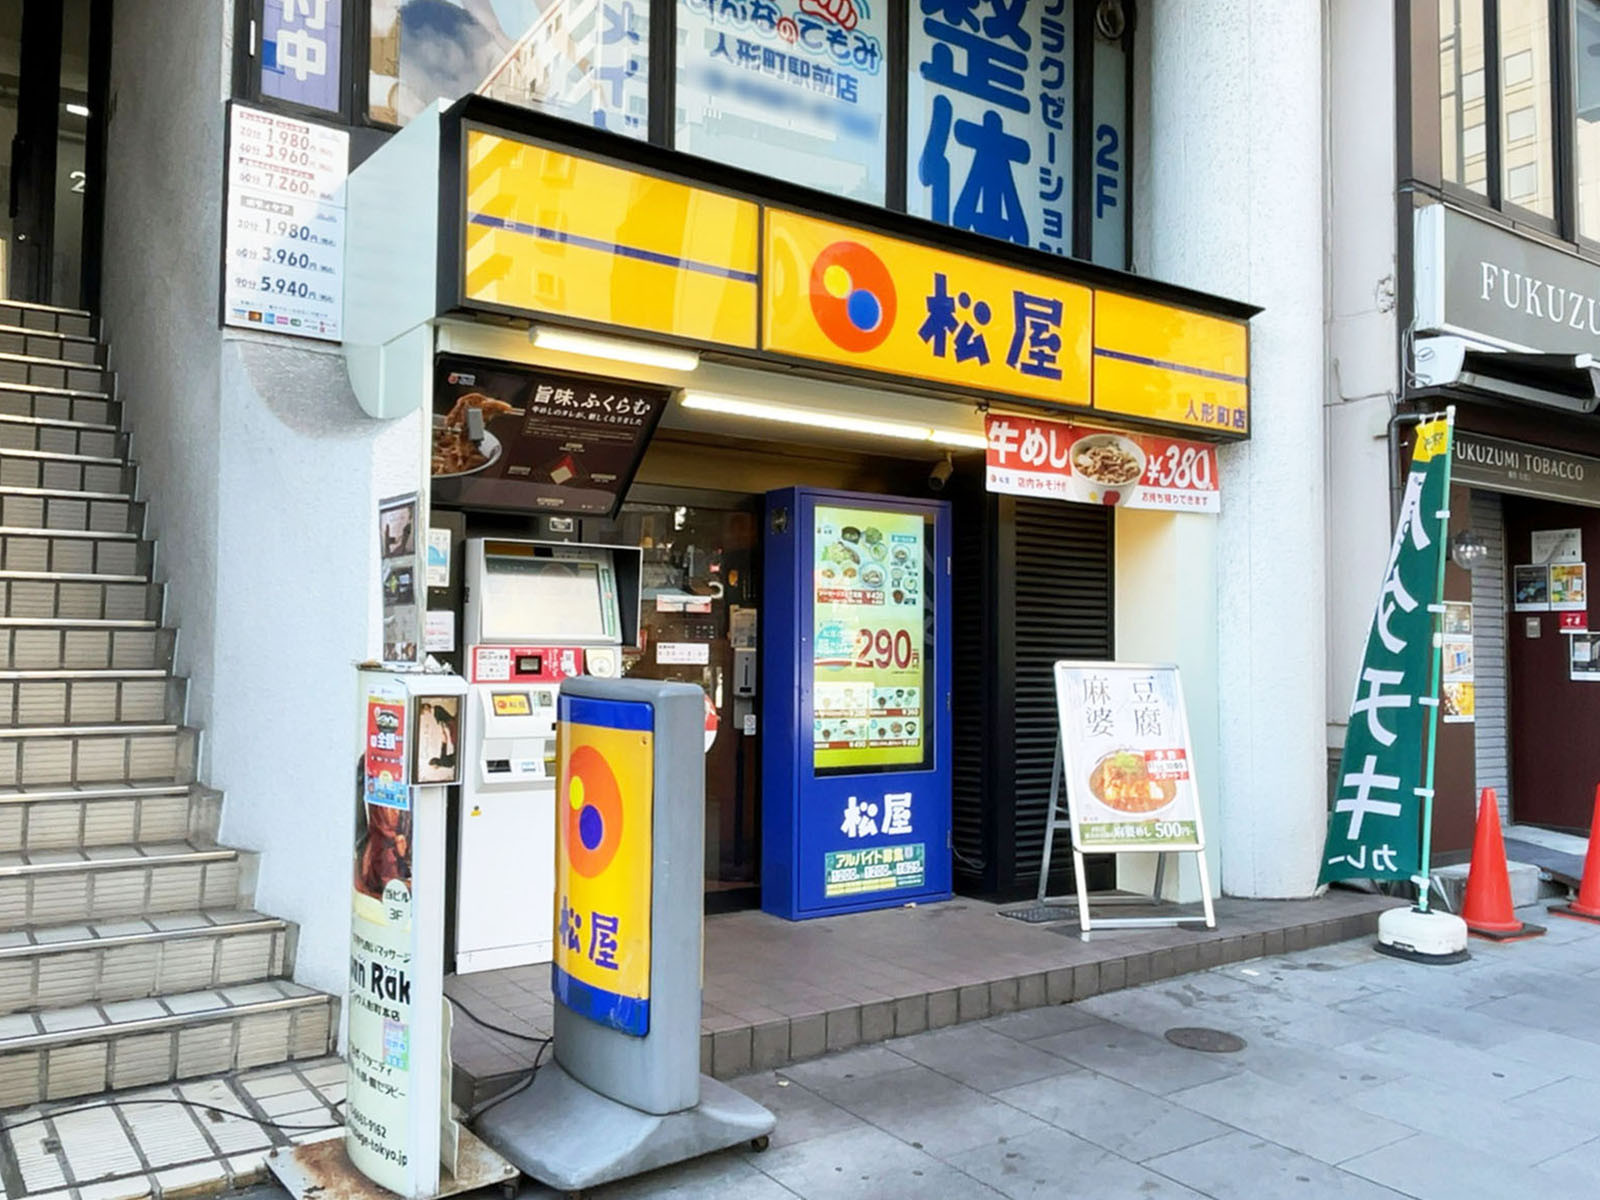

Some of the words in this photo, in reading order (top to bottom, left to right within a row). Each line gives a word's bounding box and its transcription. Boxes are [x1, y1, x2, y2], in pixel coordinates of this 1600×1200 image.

[710, 32, 858, 103] 人形町駅前店
[1097, 124, 1119, 219] 2F
[918, 273, 1064, 381] 松屋
[534, 385, 650, 415] 旨味、ふくらむ
[1185, 399, 1246, 429] 人形町店
[989, 420, 1068, 469] 牛めし
[1450, 440, 1519, 469] UKUZUMI
[1524, 454, 1584, 480] TOBACCO
[1141, 492, 1208, 505] お持ち帰りできます
[855, 628, 912, 669] 290
[840, 792, 913, 838] 松屋
[558, 895, 619, 970] 松屋
